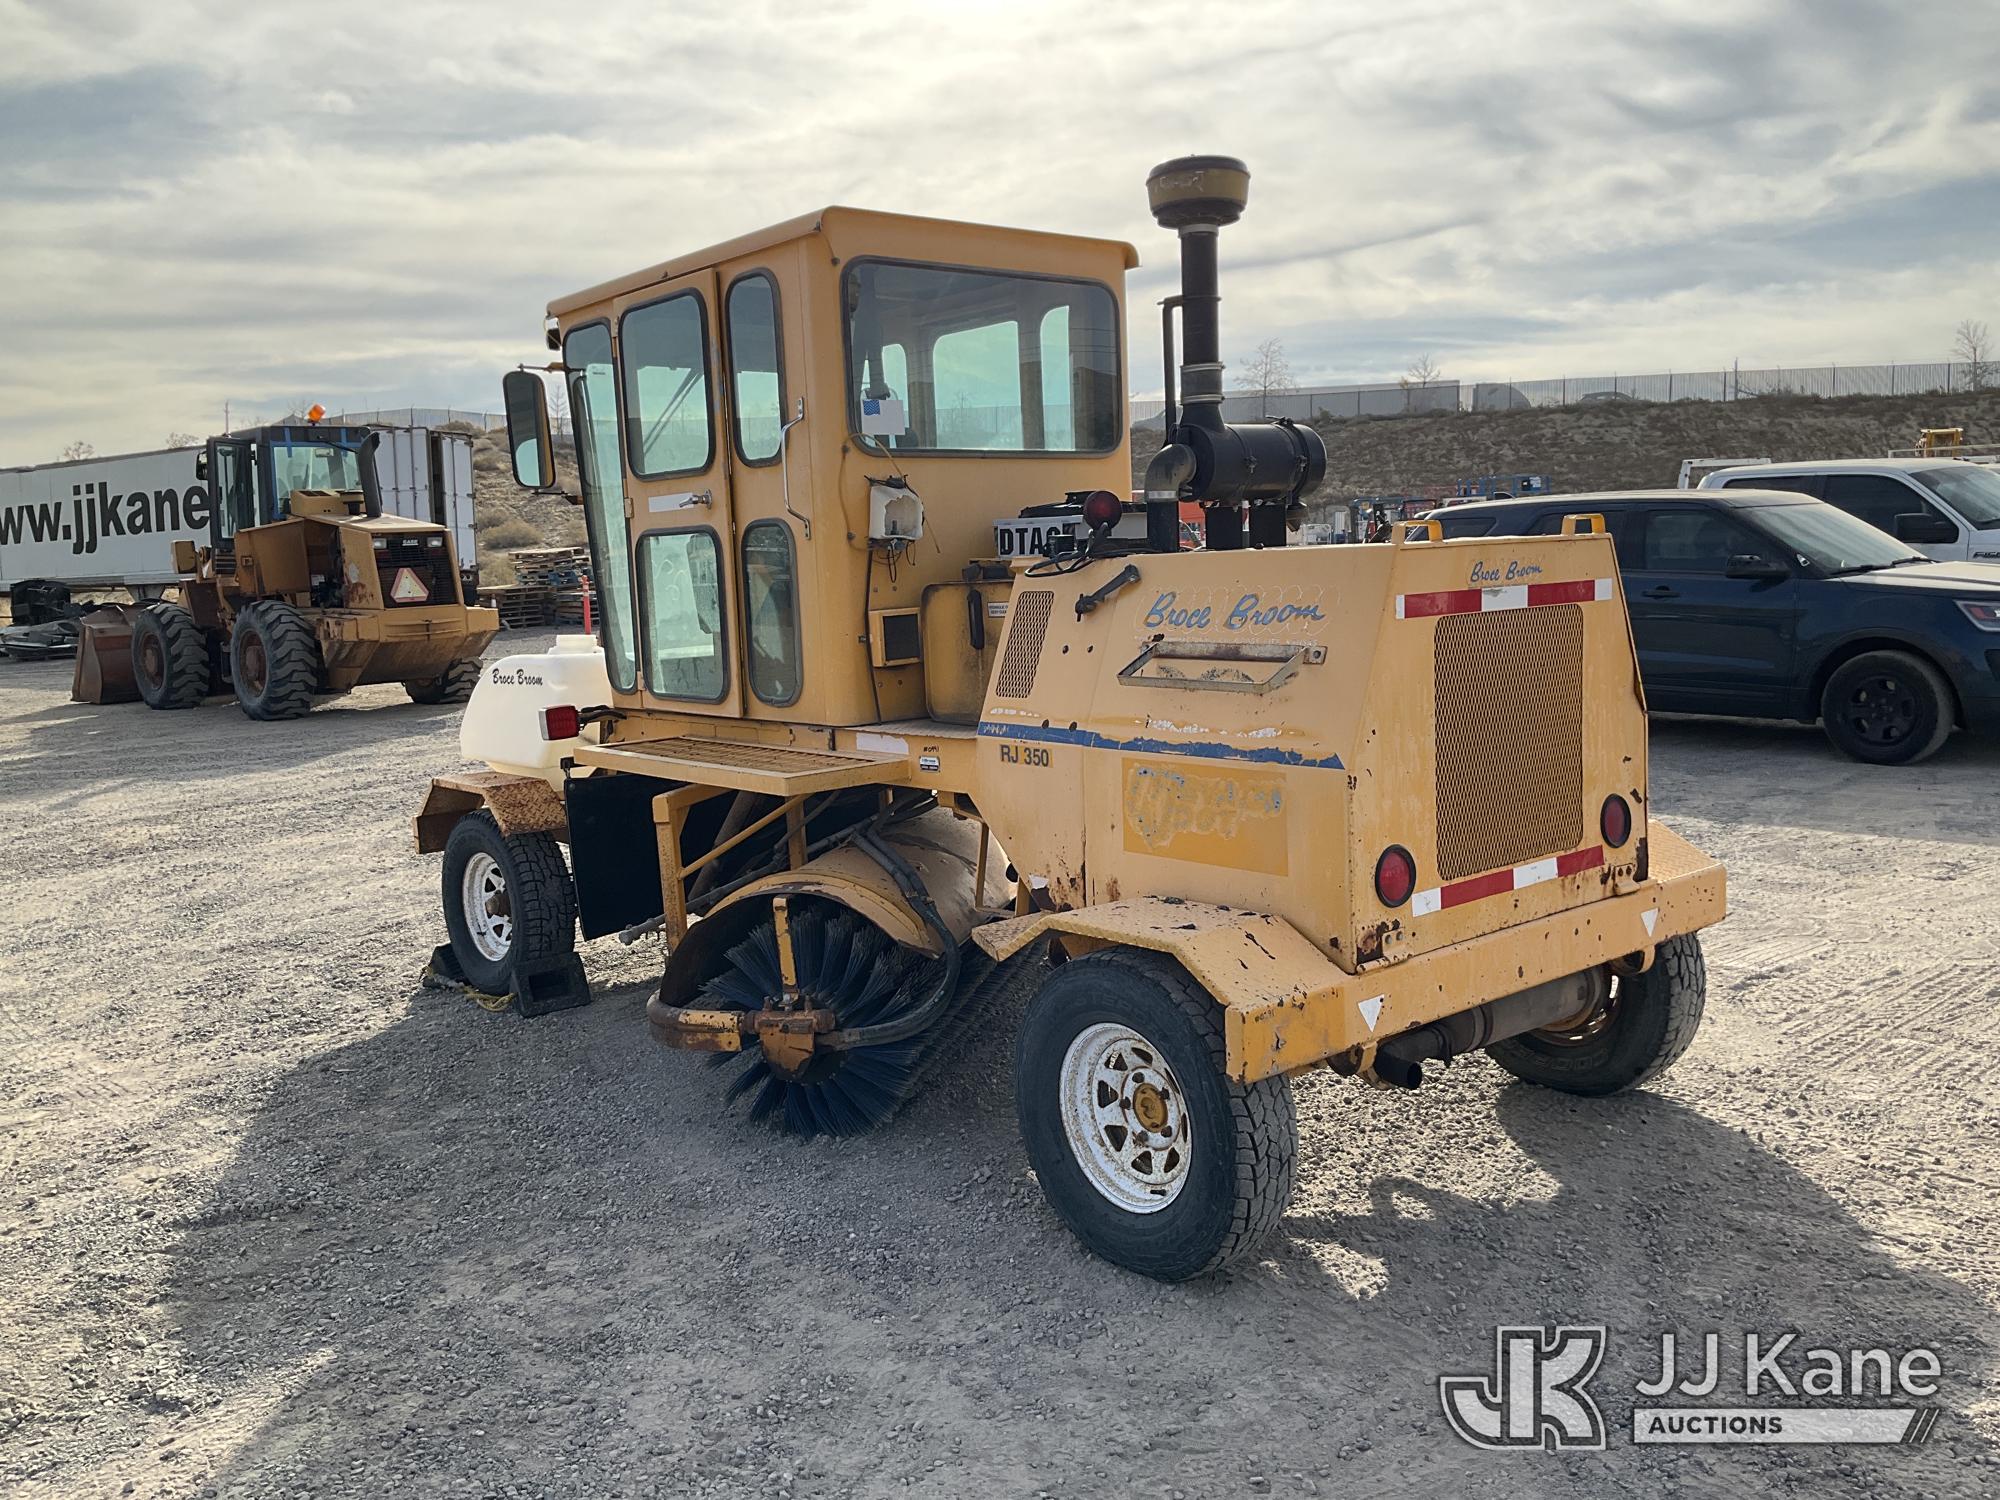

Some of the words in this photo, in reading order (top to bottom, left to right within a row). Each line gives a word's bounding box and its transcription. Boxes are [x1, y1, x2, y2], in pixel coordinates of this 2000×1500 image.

[1470, 561, 1500, 582] Broce
[1505, 560, 1543, 580] Broom
[1143, 591, 1211, 629] Broce
[1223, 593, 1326, 630] Broom
[492, 668, 514, 685] Broce
[516, 668, 543, 686] Broom
[1000, 744, 1019, 763] RJ
[1023, 747, 1049, 767] 350
